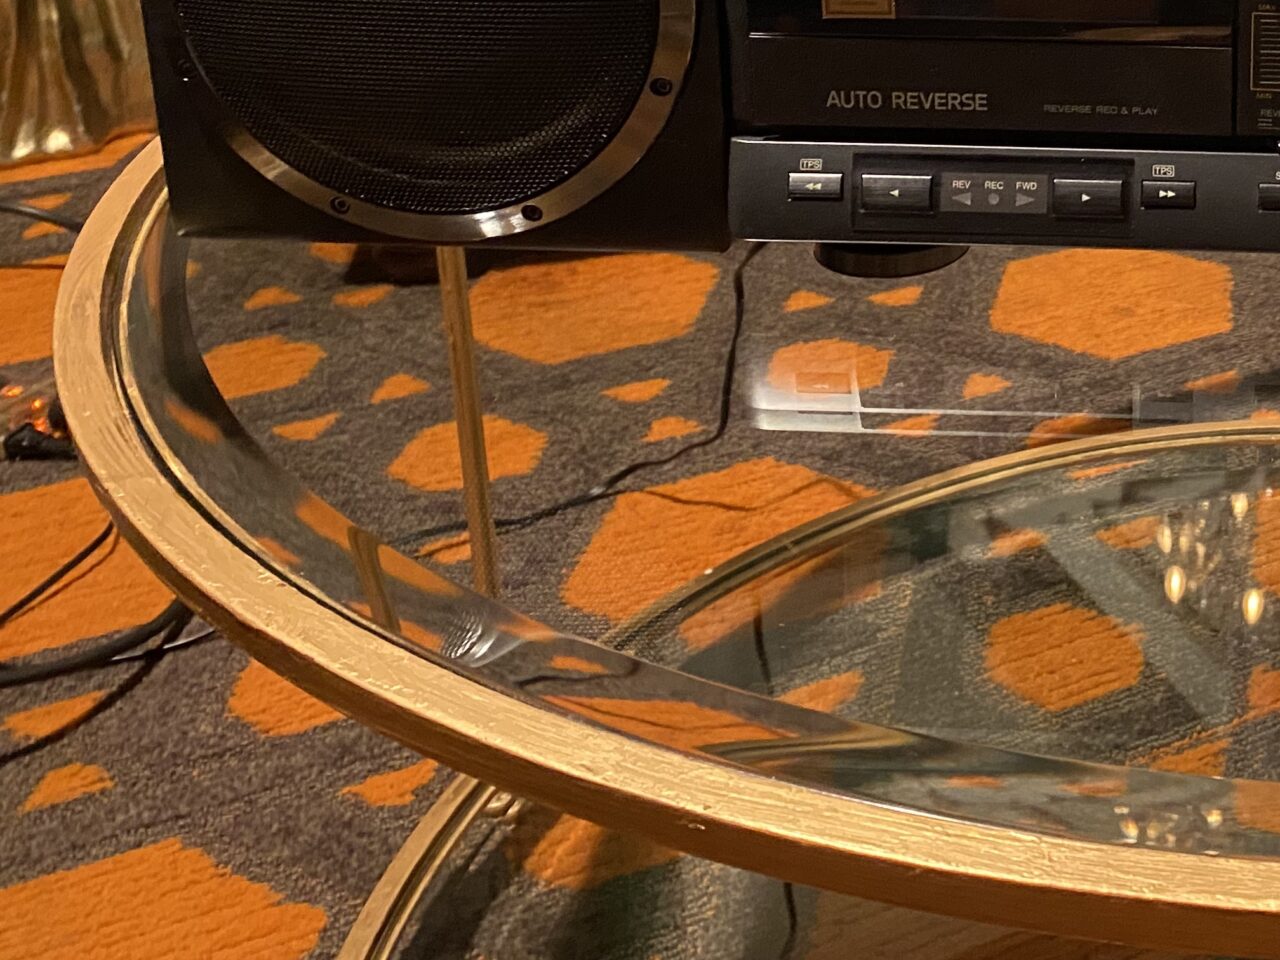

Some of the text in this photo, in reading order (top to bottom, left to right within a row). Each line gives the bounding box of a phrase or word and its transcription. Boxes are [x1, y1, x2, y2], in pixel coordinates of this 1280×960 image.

[826, 91, 988, 112] AUTO REVERSE
[1043, 103, 1158, 117] REVERSE REC & PLAY
[802, 160, 821, 170] TPS
[1154, 166, 1174, 176] TPS
[952, 179, 971, 189] REV
[984, 180, 1004, 190] REC
[1016, 181, 1037, 191] FWD
